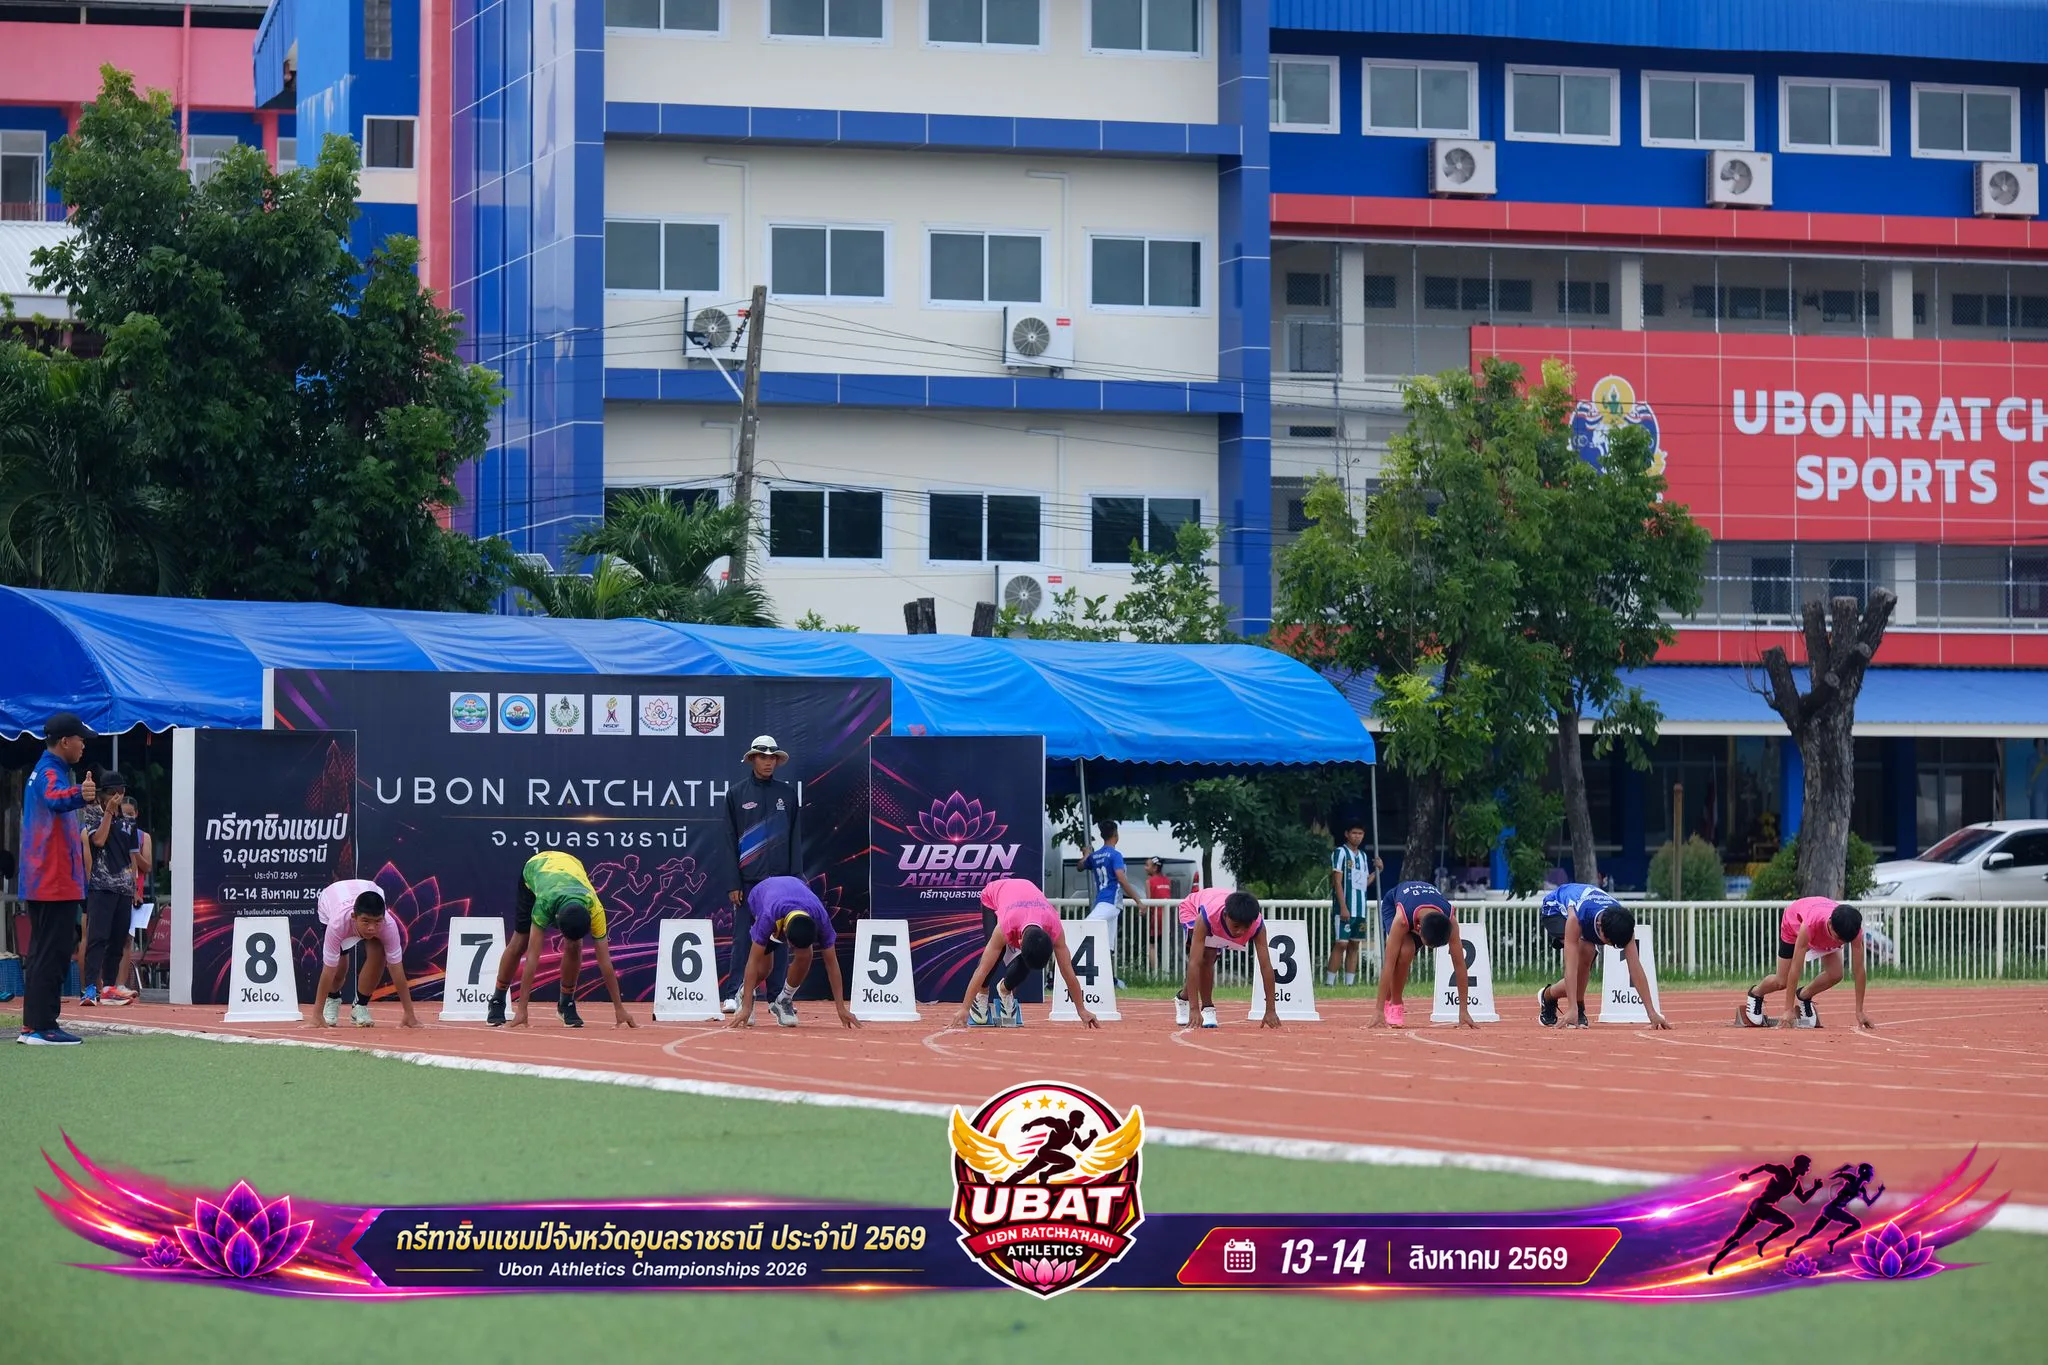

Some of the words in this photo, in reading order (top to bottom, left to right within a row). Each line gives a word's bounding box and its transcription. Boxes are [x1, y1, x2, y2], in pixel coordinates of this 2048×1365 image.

[1796, 455, 1997, 504] SPORTS
[692, 716, 718, 724] UBAT
[376, 776, 504, 805] UBON
[529, 778, 803, 808] RATCHATHI
[205, 812, 348, 841] กรีฑาชิงแชมป์
[491, 825, 688, 853] จ.อุบลราชธานี
[222, 843, 328, 869] จ.อุบลราชธานี
[898, 844, 1021, 870] UBON
[254, 870, 278, 880] ประจำปี
[280, 871, 298, 880] 2569
[261, 887, 300, 900] สิงหาคม
[245, 932, 278, 984] 8
[460, 933, 493, 985] 7
[671, 932, 702, 983] 6
[867, 934, 898, 985] 5
[1071, 935, 1099, 986] 4
[1268, 934, 1297, 984] 3
[241, 987, 280, 1003] Nelco
[667, 986, 704, 1001] Nelco
[862, 988, 899, 1003] Nelco
